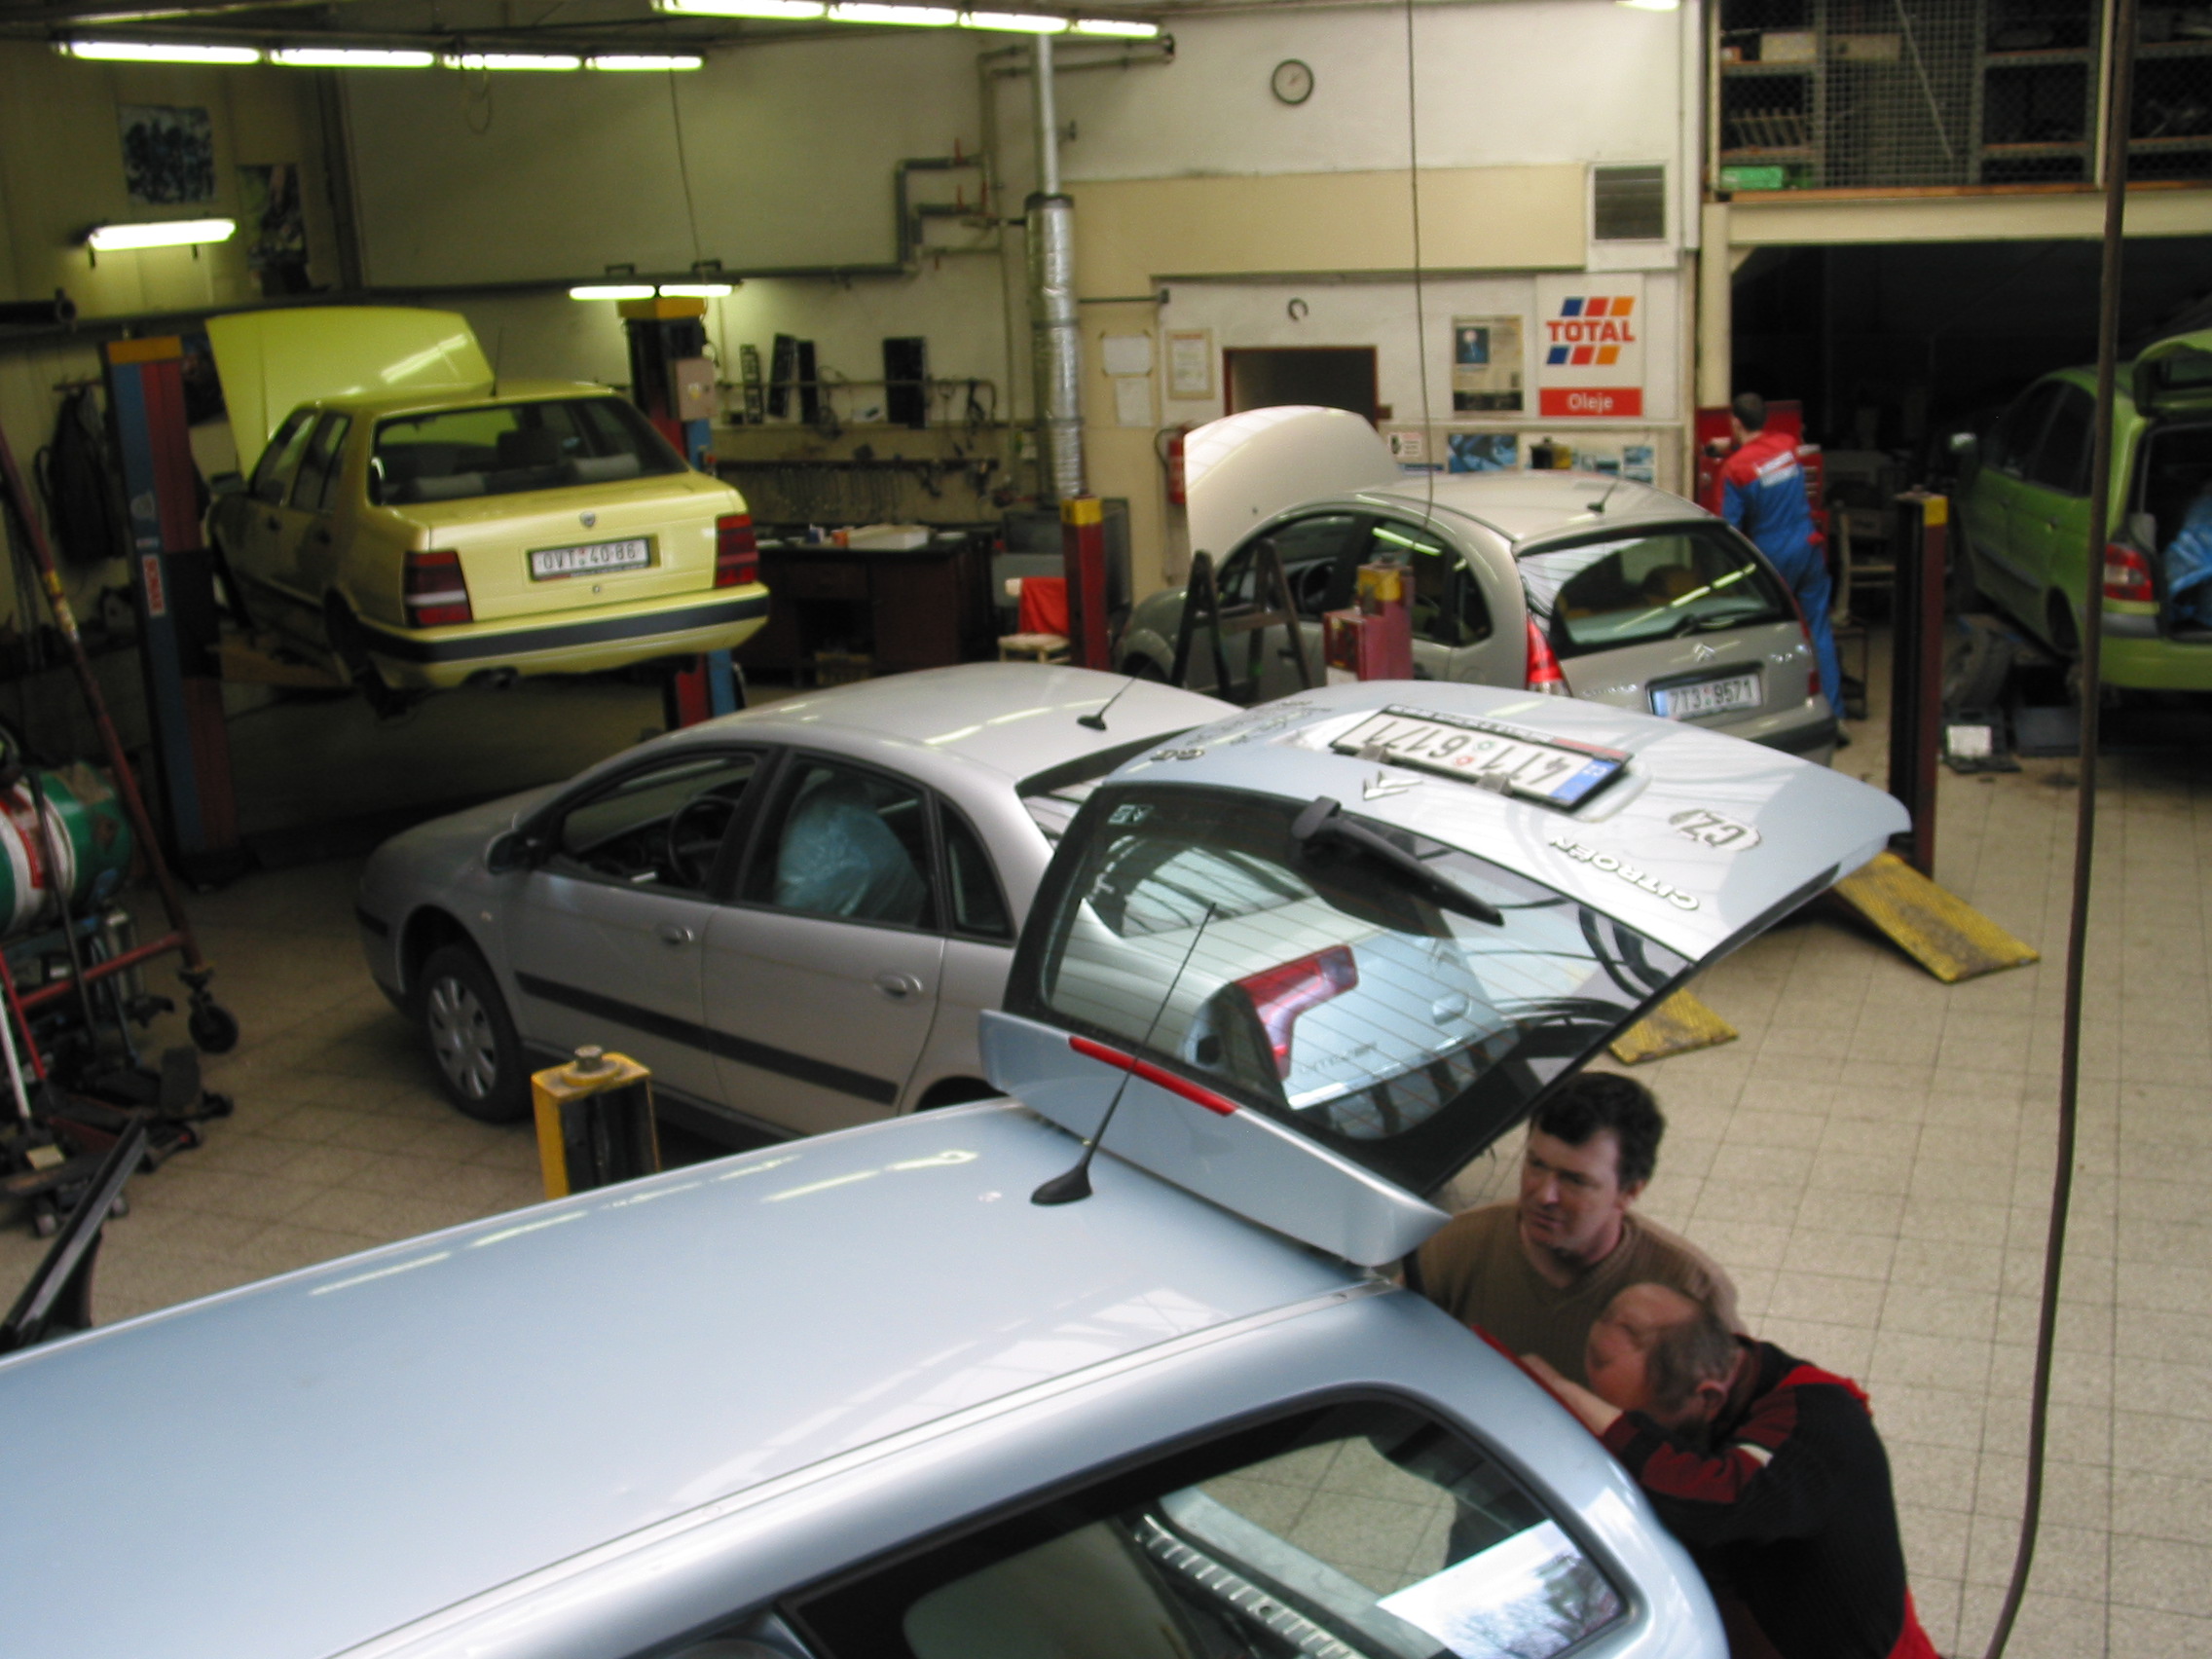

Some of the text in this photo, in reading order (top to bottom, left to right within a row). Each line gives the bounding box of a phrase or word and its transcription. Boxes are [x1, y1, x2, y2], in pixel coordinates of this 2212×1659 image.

[1546, 320, 1636, 342] TOTAL
[1567, 392, 1613, 414] Oleje
[1714, 678, 1753, 706] 9571
[1550, 835, 1700, 910] CITROËN
